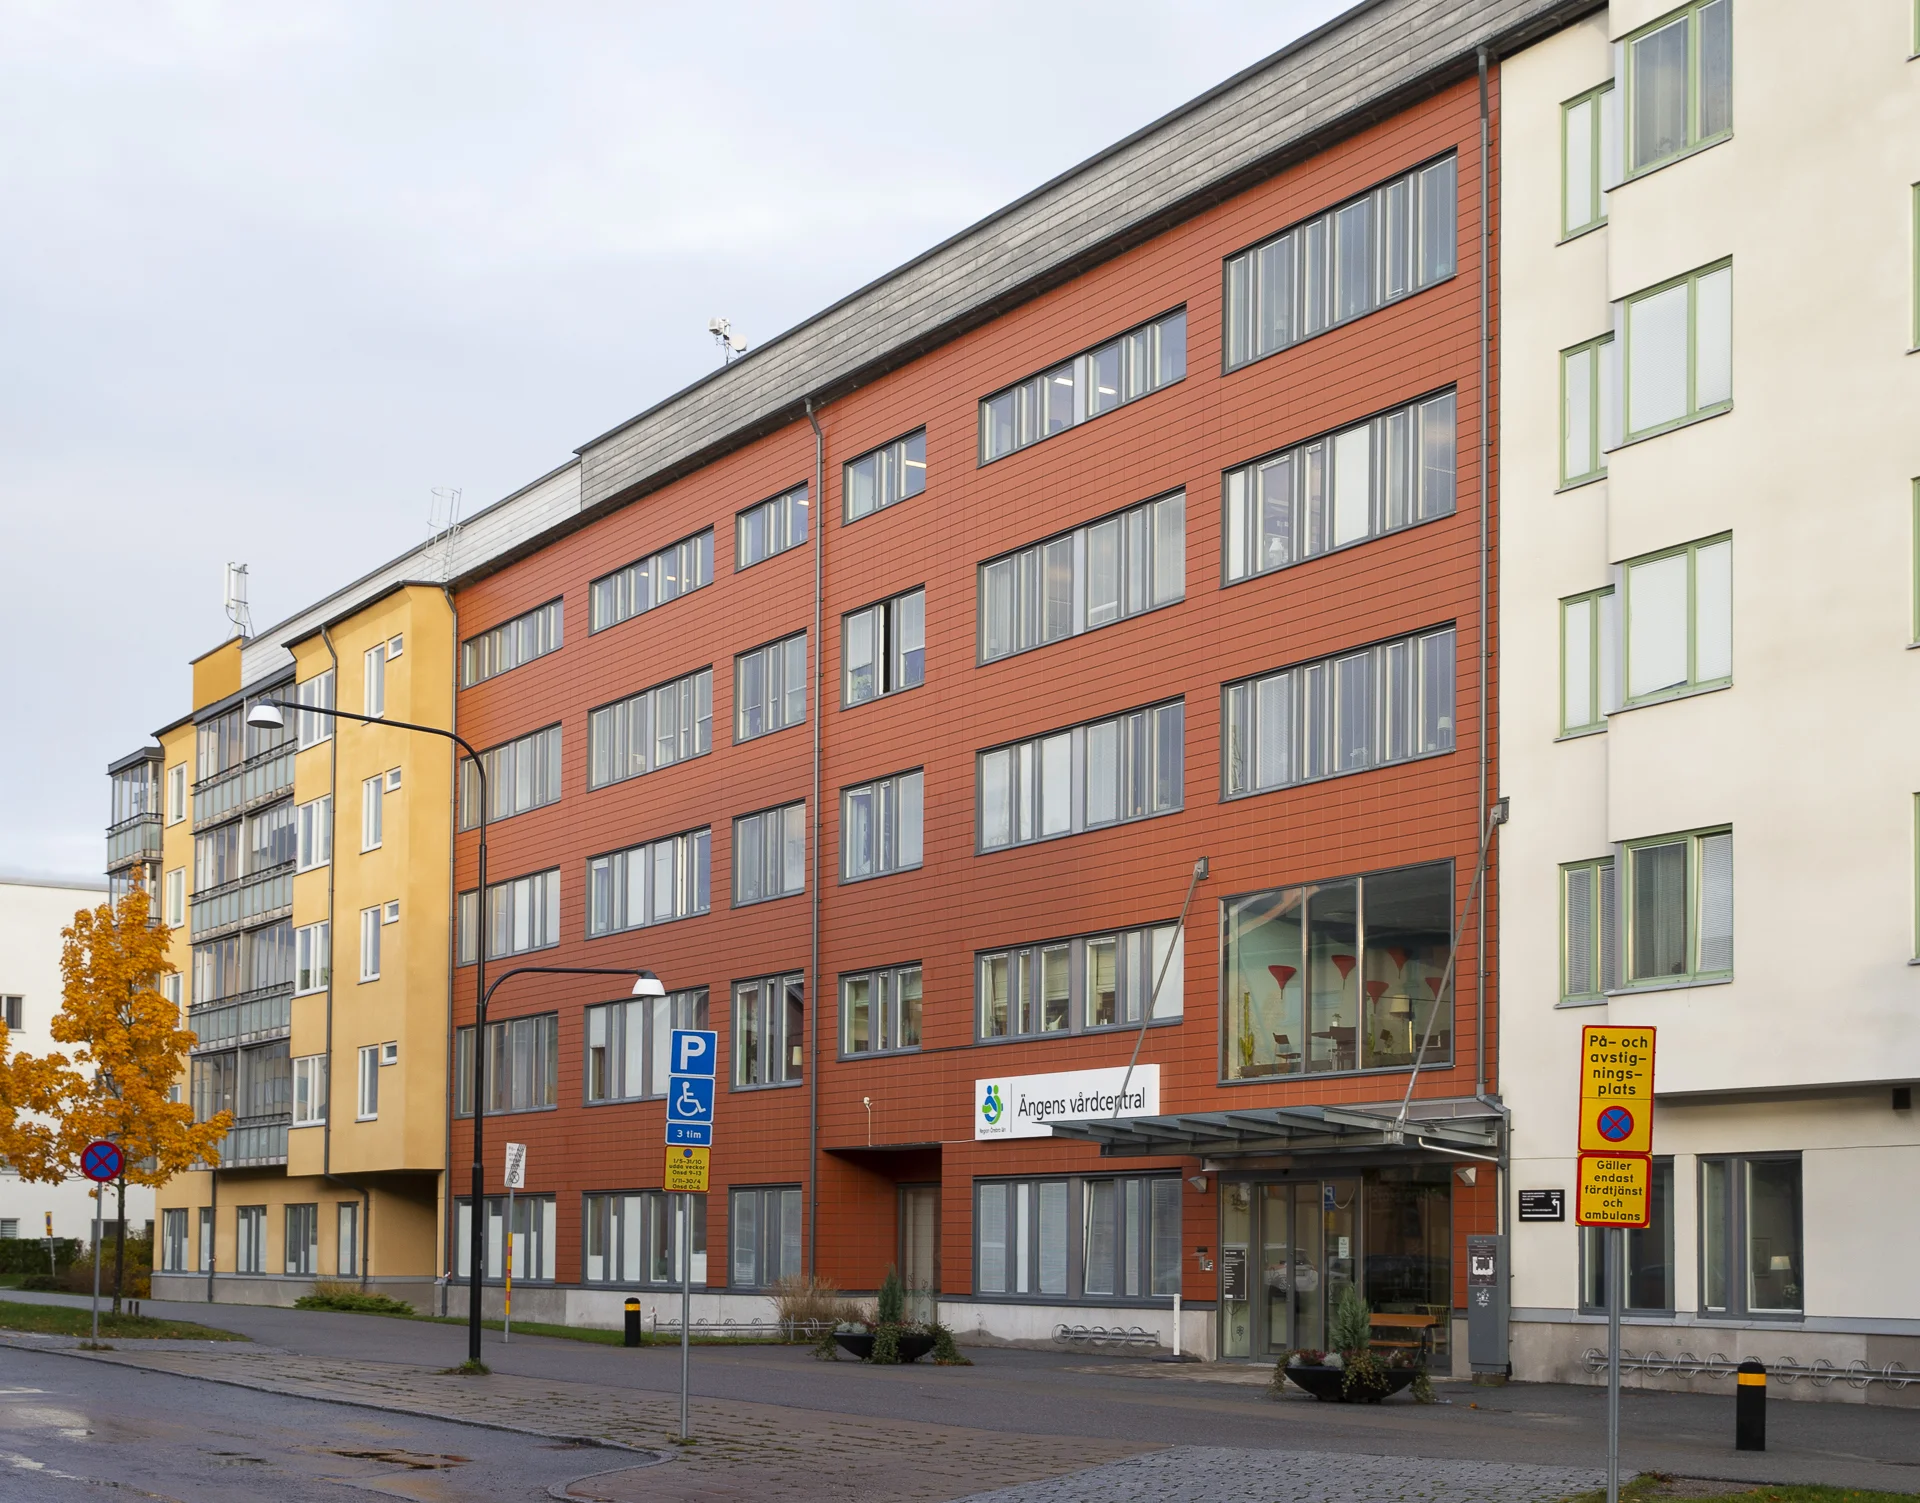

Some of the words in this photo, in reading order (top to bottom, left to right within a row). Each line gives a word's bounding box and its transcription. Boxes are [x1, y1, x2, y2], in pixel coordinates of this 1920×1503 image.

[1590, 1035, 1616, 1047] På-
[1621, 1036, 1648, 1048] och
[680, 1034, 707, 1070] P
[1590, 1051, 1647, 1066] avstig-
[1593, 1066, 1643, 1082] nings-
[1598, 1083, 1636, 1097] plats
[1018, 1094, 1066, 1120] Ängens
[1069, 1087, 1146, 1113] vårdcentral
[677, 1130, 683, 1138] 3
[686, 1130, 702, 1138] tim
[1596, 1160, 1632, 1170] Gäller
[1594, 1173, 1634, 1183] endast
[1585, 1185, 1643, 1197] färdtjänst
[1602, 1198, 1623, 1208] och
[1585, 1210, 1641, 1221] ambulans
